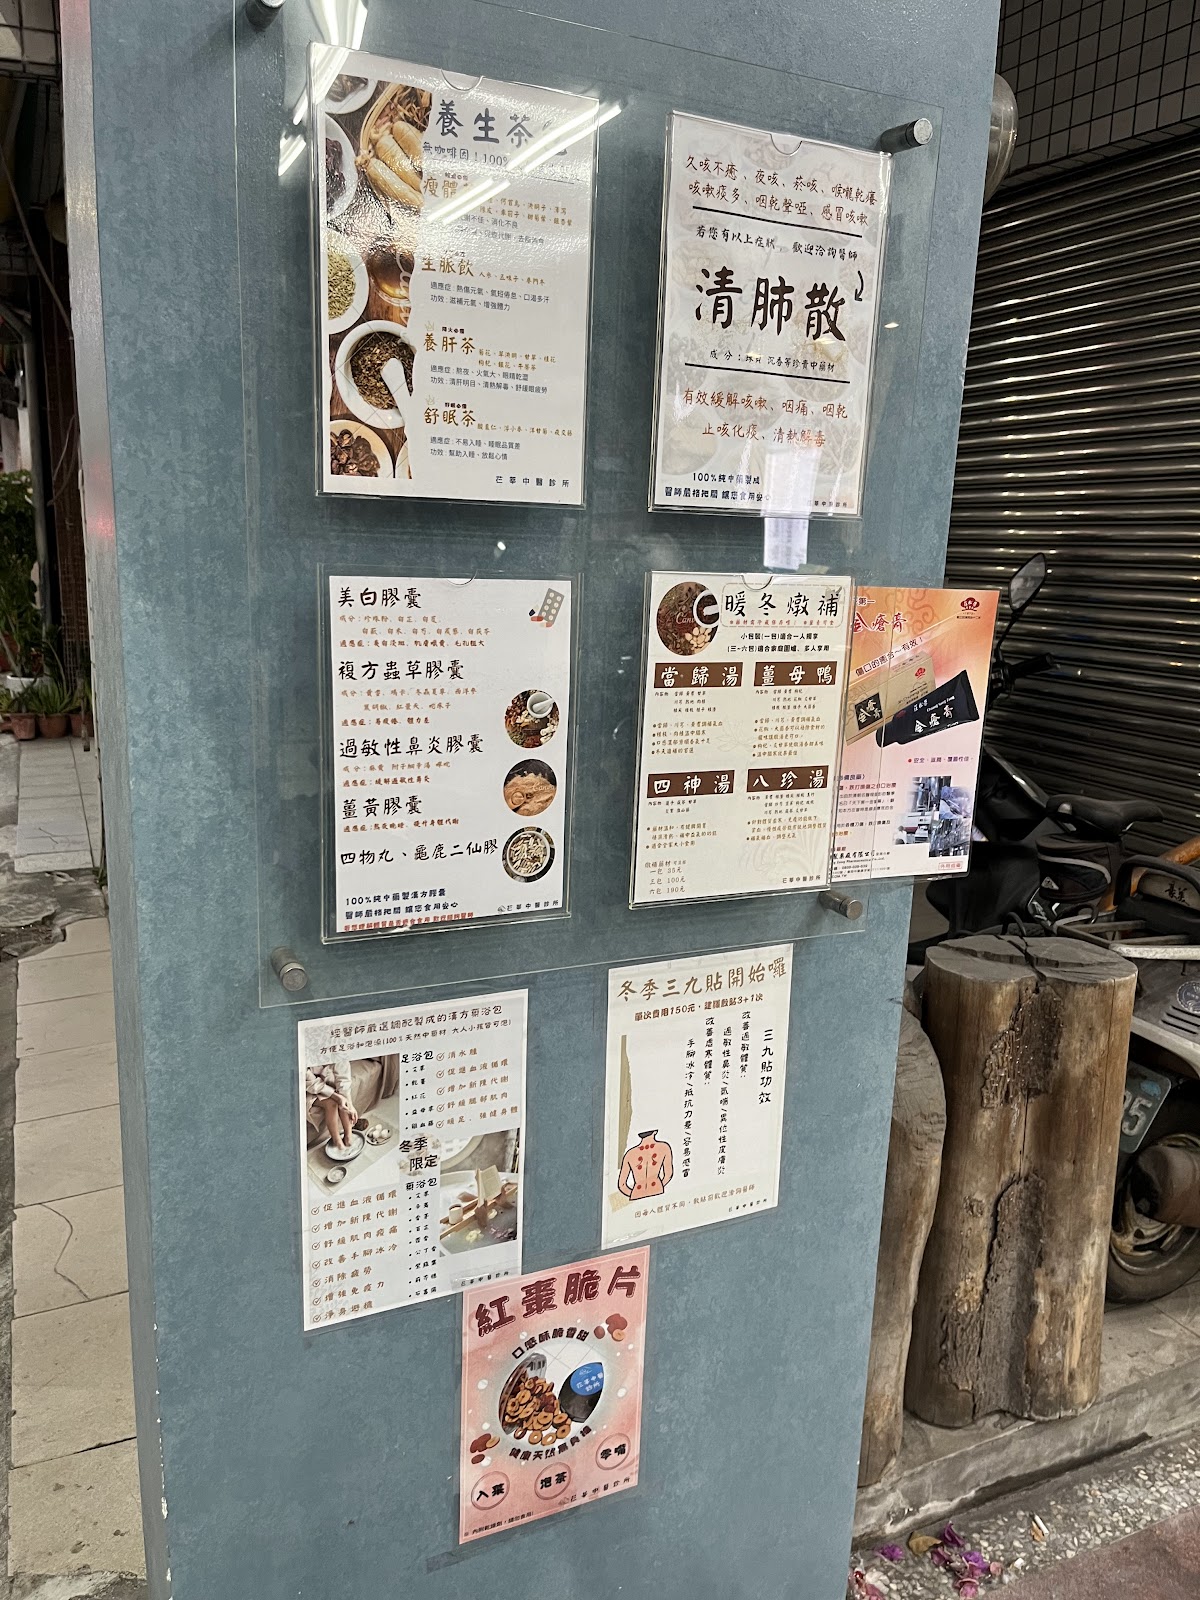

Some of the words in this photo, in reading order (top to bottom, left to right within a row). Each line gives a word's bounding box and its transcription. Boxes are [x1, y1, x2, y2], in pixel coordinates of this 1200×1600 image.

[695, 265, 846, 342] 清肺散
[423, 332, 476, 355] 養肝茶
[423, 407, 477, 428] 舒眠茶
[701, 422, 827, 448] 止咳化痰、清熱解毒
[337, 586, 422, 609] 美白膠囊
[724, 590, 840, 618] 暖冬燉補
[337, 659, 464, 681] 複方蟲草膠囊
[661, 665, 739, 688] 當歸湯
[761, 664, 833, 687] 薑母鴨
[339, 733, 484, 759] 過敏性鼻炎膠囊
[653, 773, 731, 795] 四神湯
[752, 768, 825, 790] 八珍湯
[342, 794, 423, 820] 薑黃膠囊
[339, 838, 499, 866] 四物丸、龜鹿二仙膠
[616, 956, 787, 1001] 冬季三九貼開始囉
[400, 1050, 434, 1064] 足浴包
[758, 1028, 774, 1104] 三九貼功效
[399, 1135, 428, 1153] 冬季
[408, 1154, 438, 1172] 限定
[323, 1189, 397, 1212] 促進血液循環
[323, 1207, 398, 1230] 增加新陳代謝
[323, 1243, 398, 1267] 改善手腳冰冷
[324, 1265, 372, 1283] 消除疲勞
[324, 1281, 385, 1302] 增強免疫力
[475, 1265, 641, 1337] 紅棗脆片
[540, 1471, 568, 1490] 泡茶
